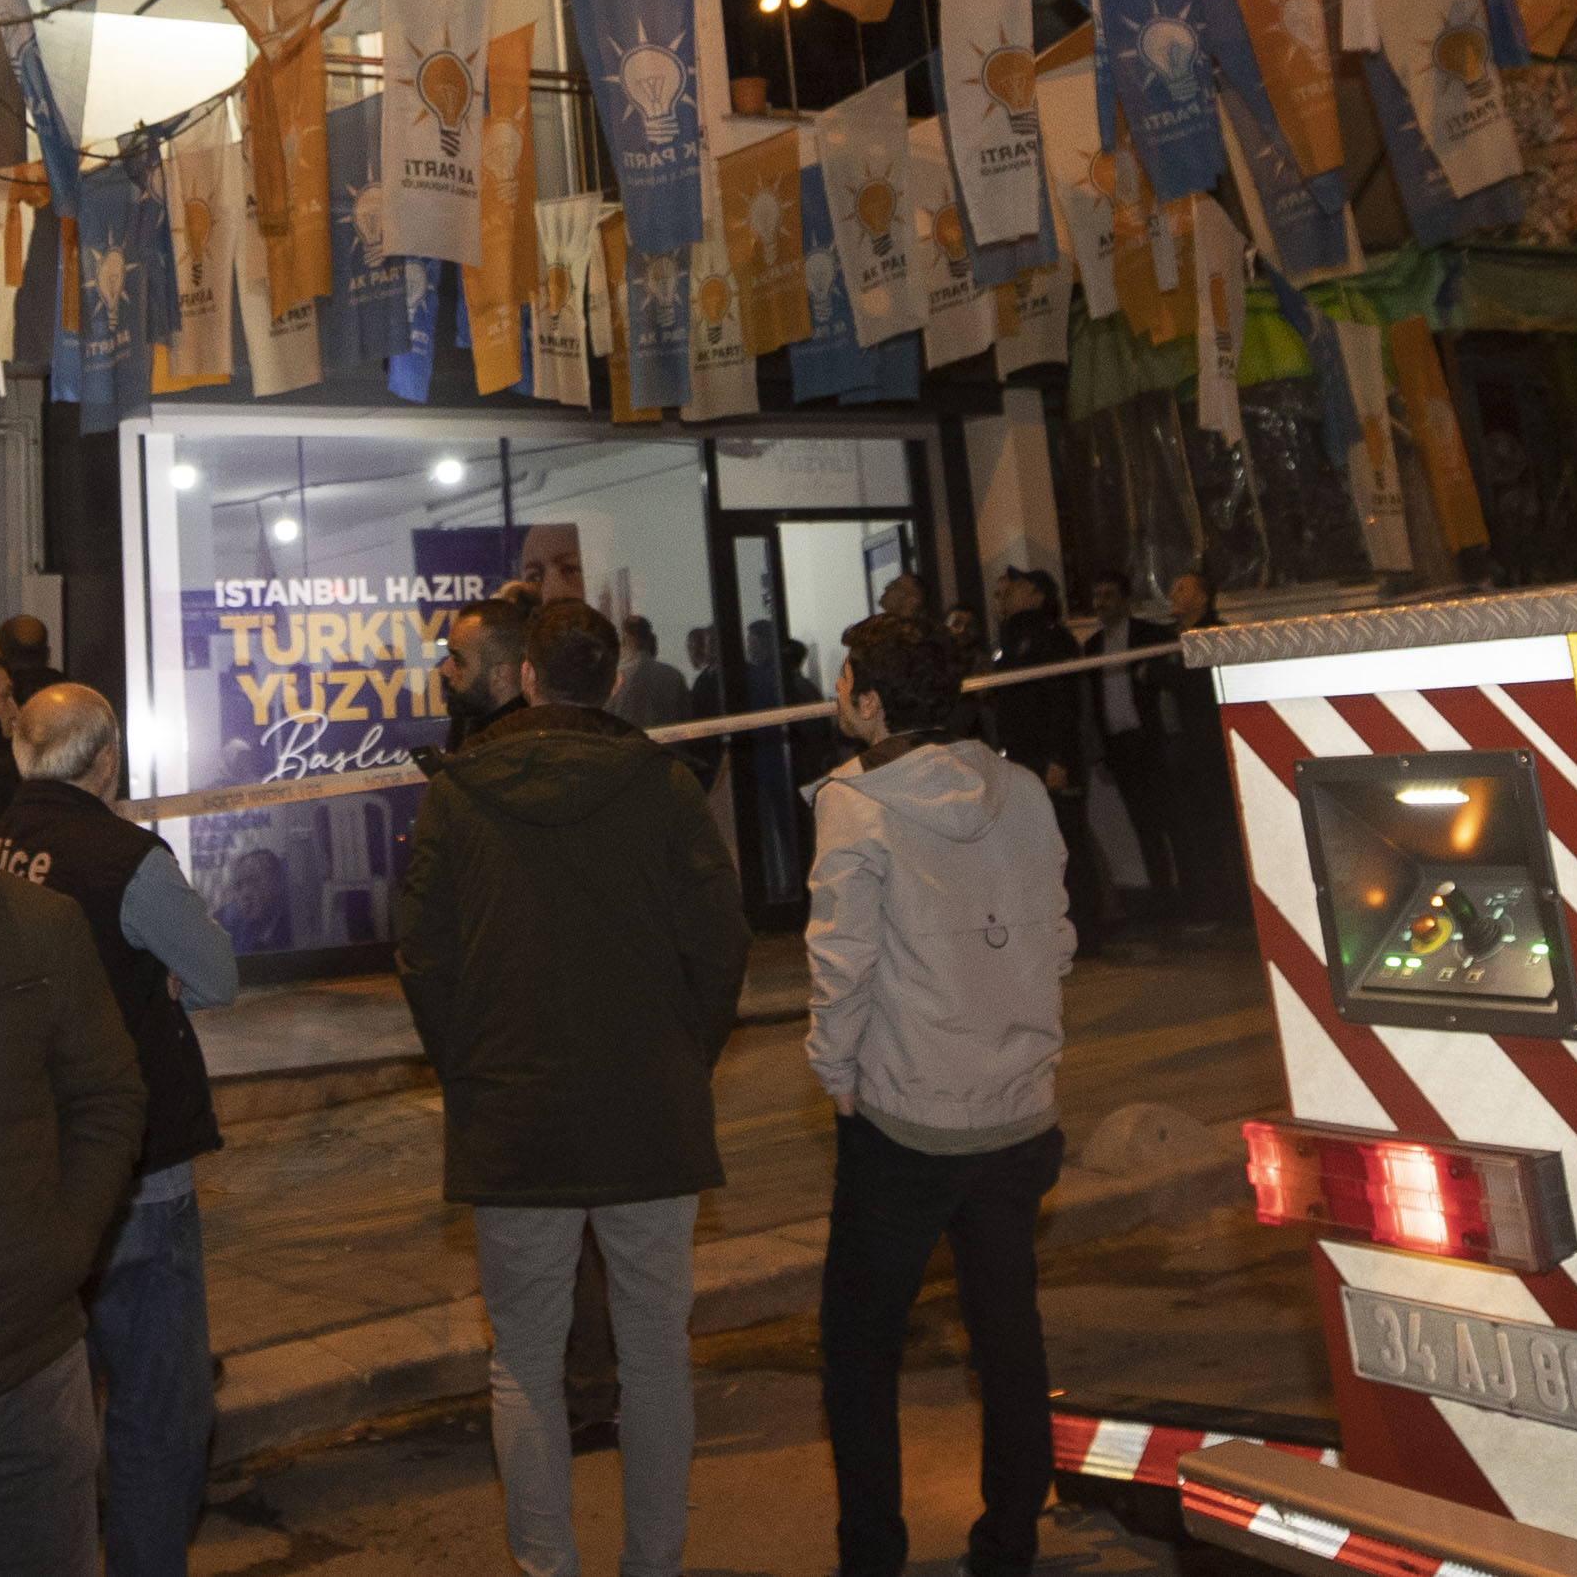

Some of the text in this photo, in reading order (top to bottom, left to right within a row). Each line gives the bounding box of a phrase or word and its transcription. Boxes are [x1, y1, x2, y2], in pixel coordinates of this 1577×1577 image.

[385, 574, 485, 604] HAZIR
[219, 608, 462, 667] TÜRKİY
[235, 666, 450, 726] YÜZYIL
